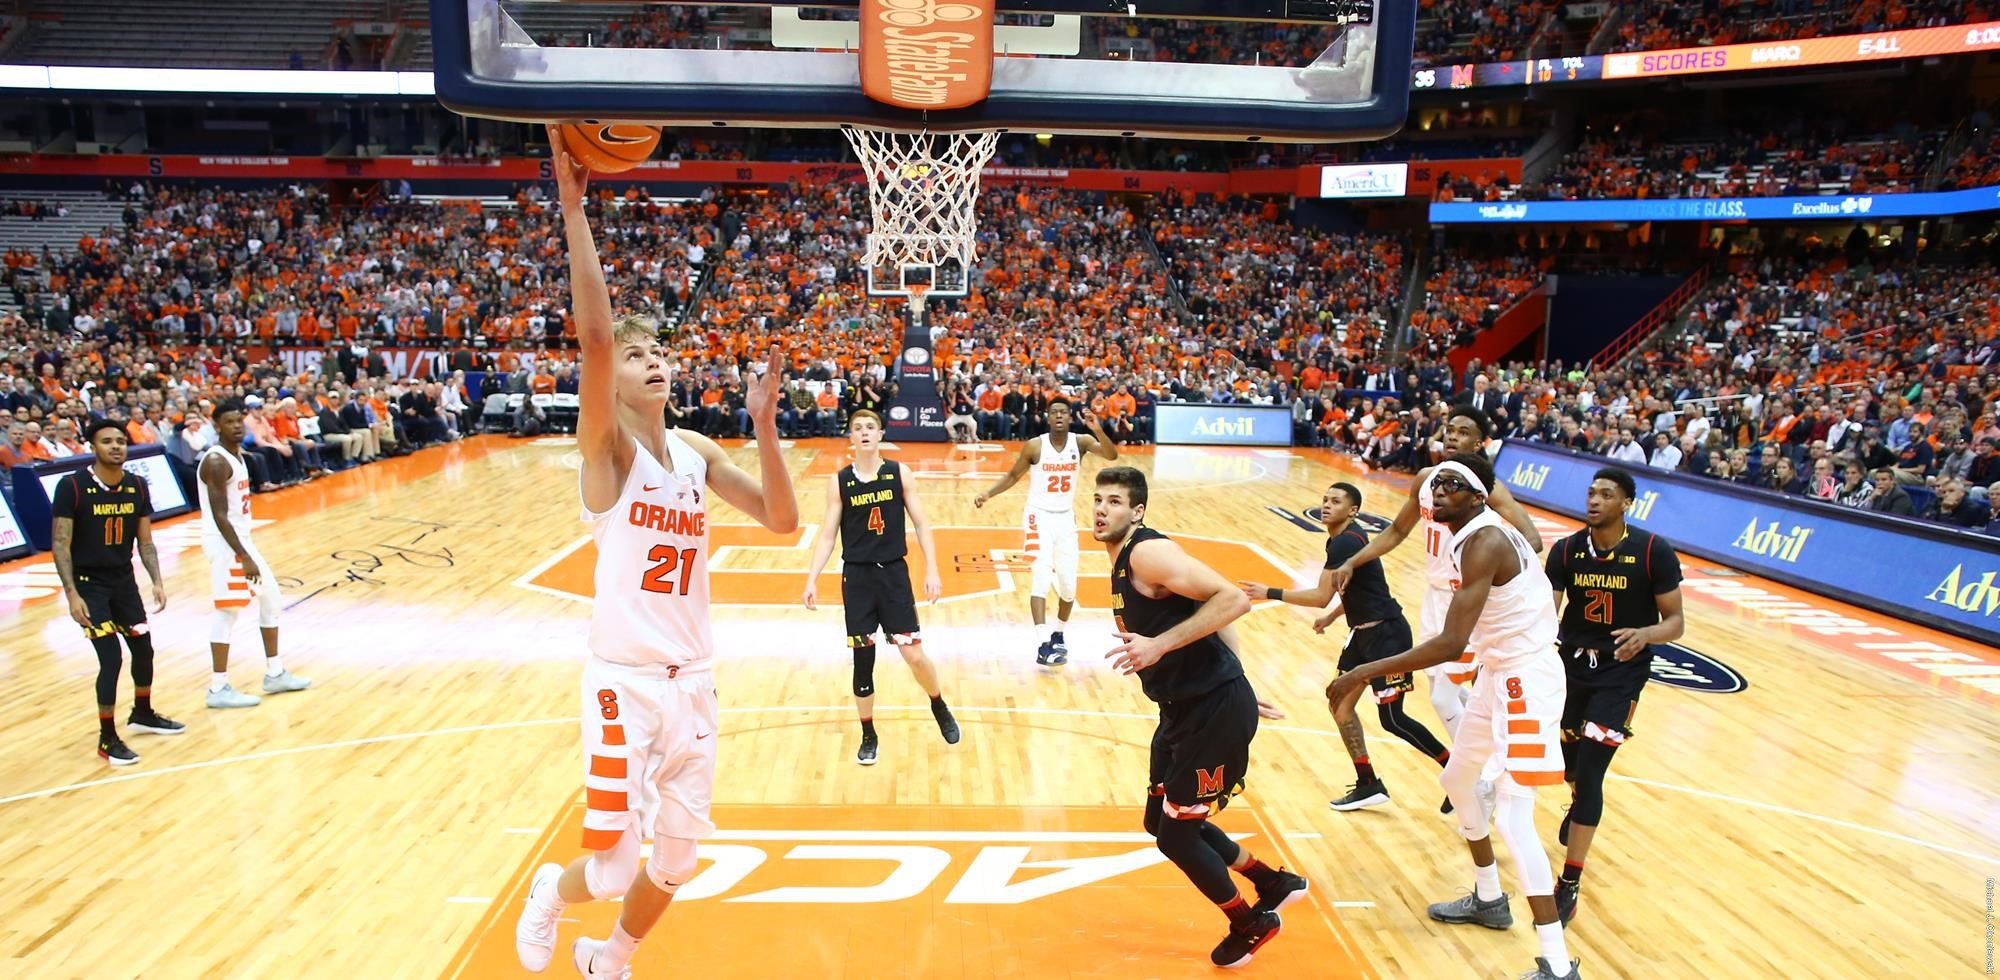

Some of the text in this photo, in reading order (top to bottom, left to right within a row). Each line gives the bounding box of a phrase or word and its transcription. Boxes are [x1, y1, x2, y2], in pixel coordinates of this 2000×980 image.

[1642, 51, 1727, 72] SCORES
[1750, 45, 1801, 63] MARQ
[200, 157, 214, 165] NEW
[1680, 200, 1701, 217] THE
[1704, 200, 1747, 217] GLASS.
[1793, 202, 1840, 215] Excellus
[1191, 416, 1254, 436] Advil
[1042, 463, 1078, 472] ORANGE
[1508, 460, 1549, 491] Advil
[1047, 475, 1071, 493] 25
[850, 489, 894, 506] MARYLAND
[93, 502, 135, 516] MARYLAND
[867, 506, 885, 535] 4
[104, 517, 124, 545] 11
[1731, 516, 1811, 563] Advil
[1427, 527, 1441, 557] 11
[641, 544, 697, 596] 21
[1574, 573, 1628, 590] MARYLAND
[1584, 590, 1613, 625] 21
[1196, 765, 1224, 795] M
